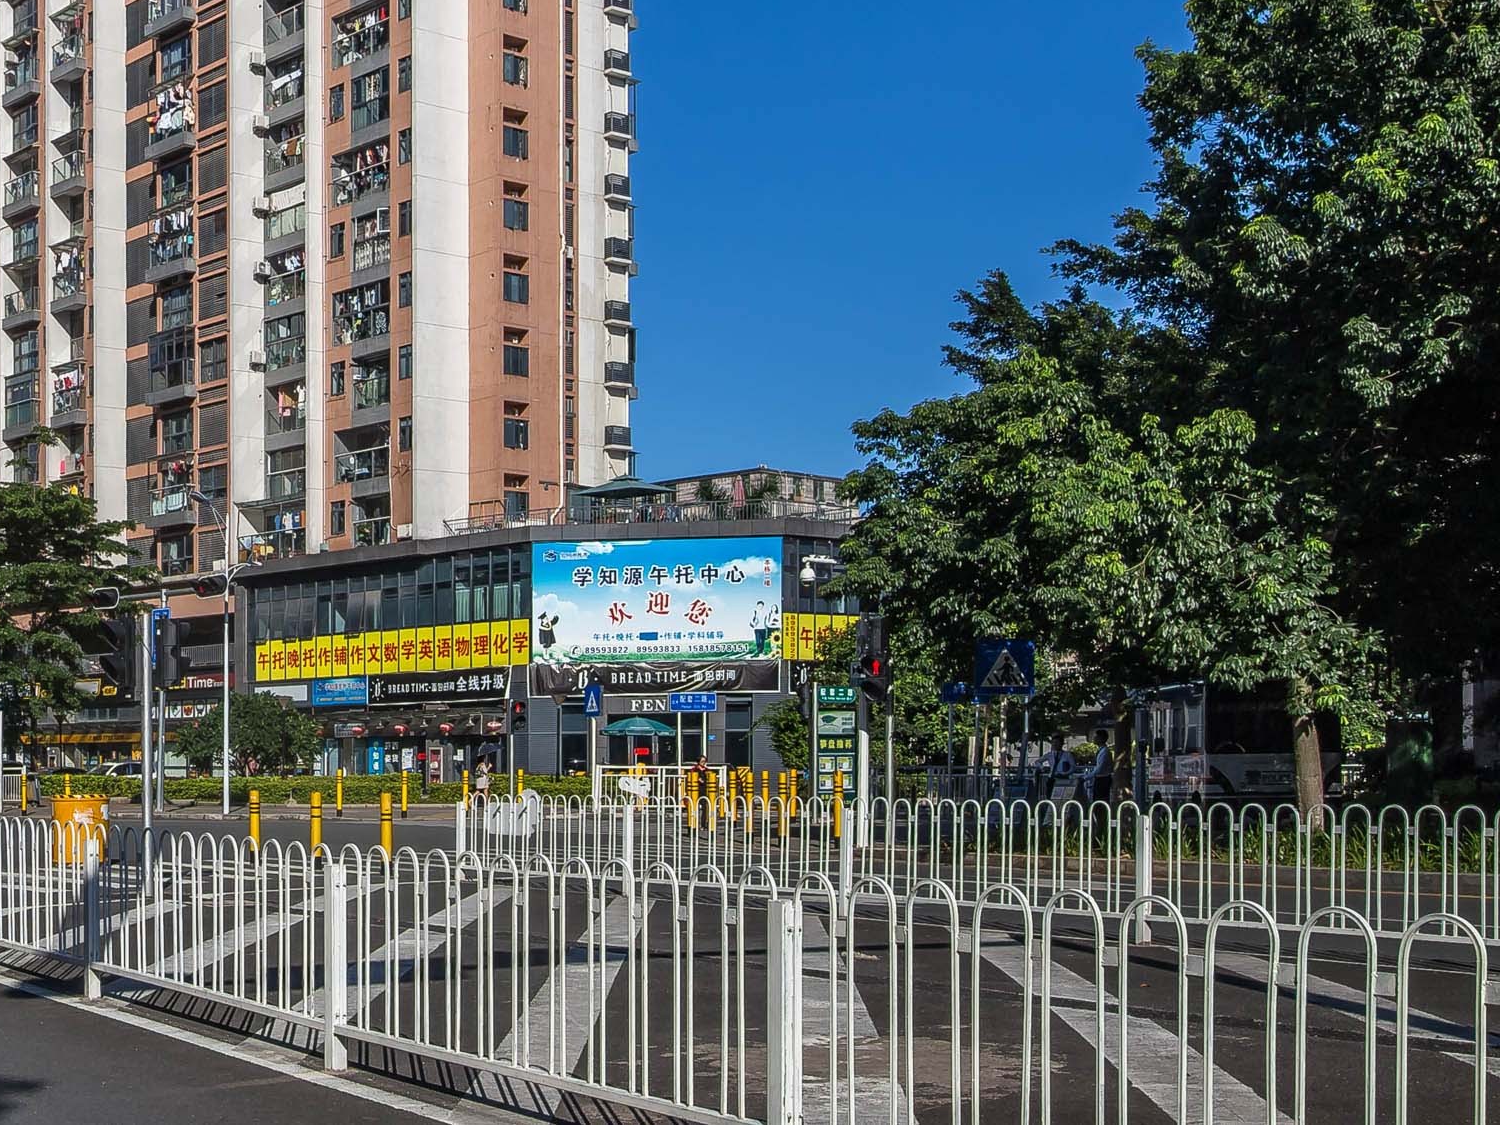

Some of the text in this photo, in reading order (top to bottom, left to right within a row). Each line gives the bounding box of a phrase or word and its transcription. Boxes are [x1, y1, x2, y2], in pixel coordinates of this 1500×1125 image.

[573, 565, 745, 587] 学知源午托中心
[258, 631, 529, 671] 午托晚托作辅作文数学英语物理化学
[584, 646, 629, 654] 89593822
[636, 645, 681, 653] 89593833
[456, 674, 505, 692] 全线升级
[611, 672, 652, 684] BREAD
[656, 671, 688, 683] TIME
